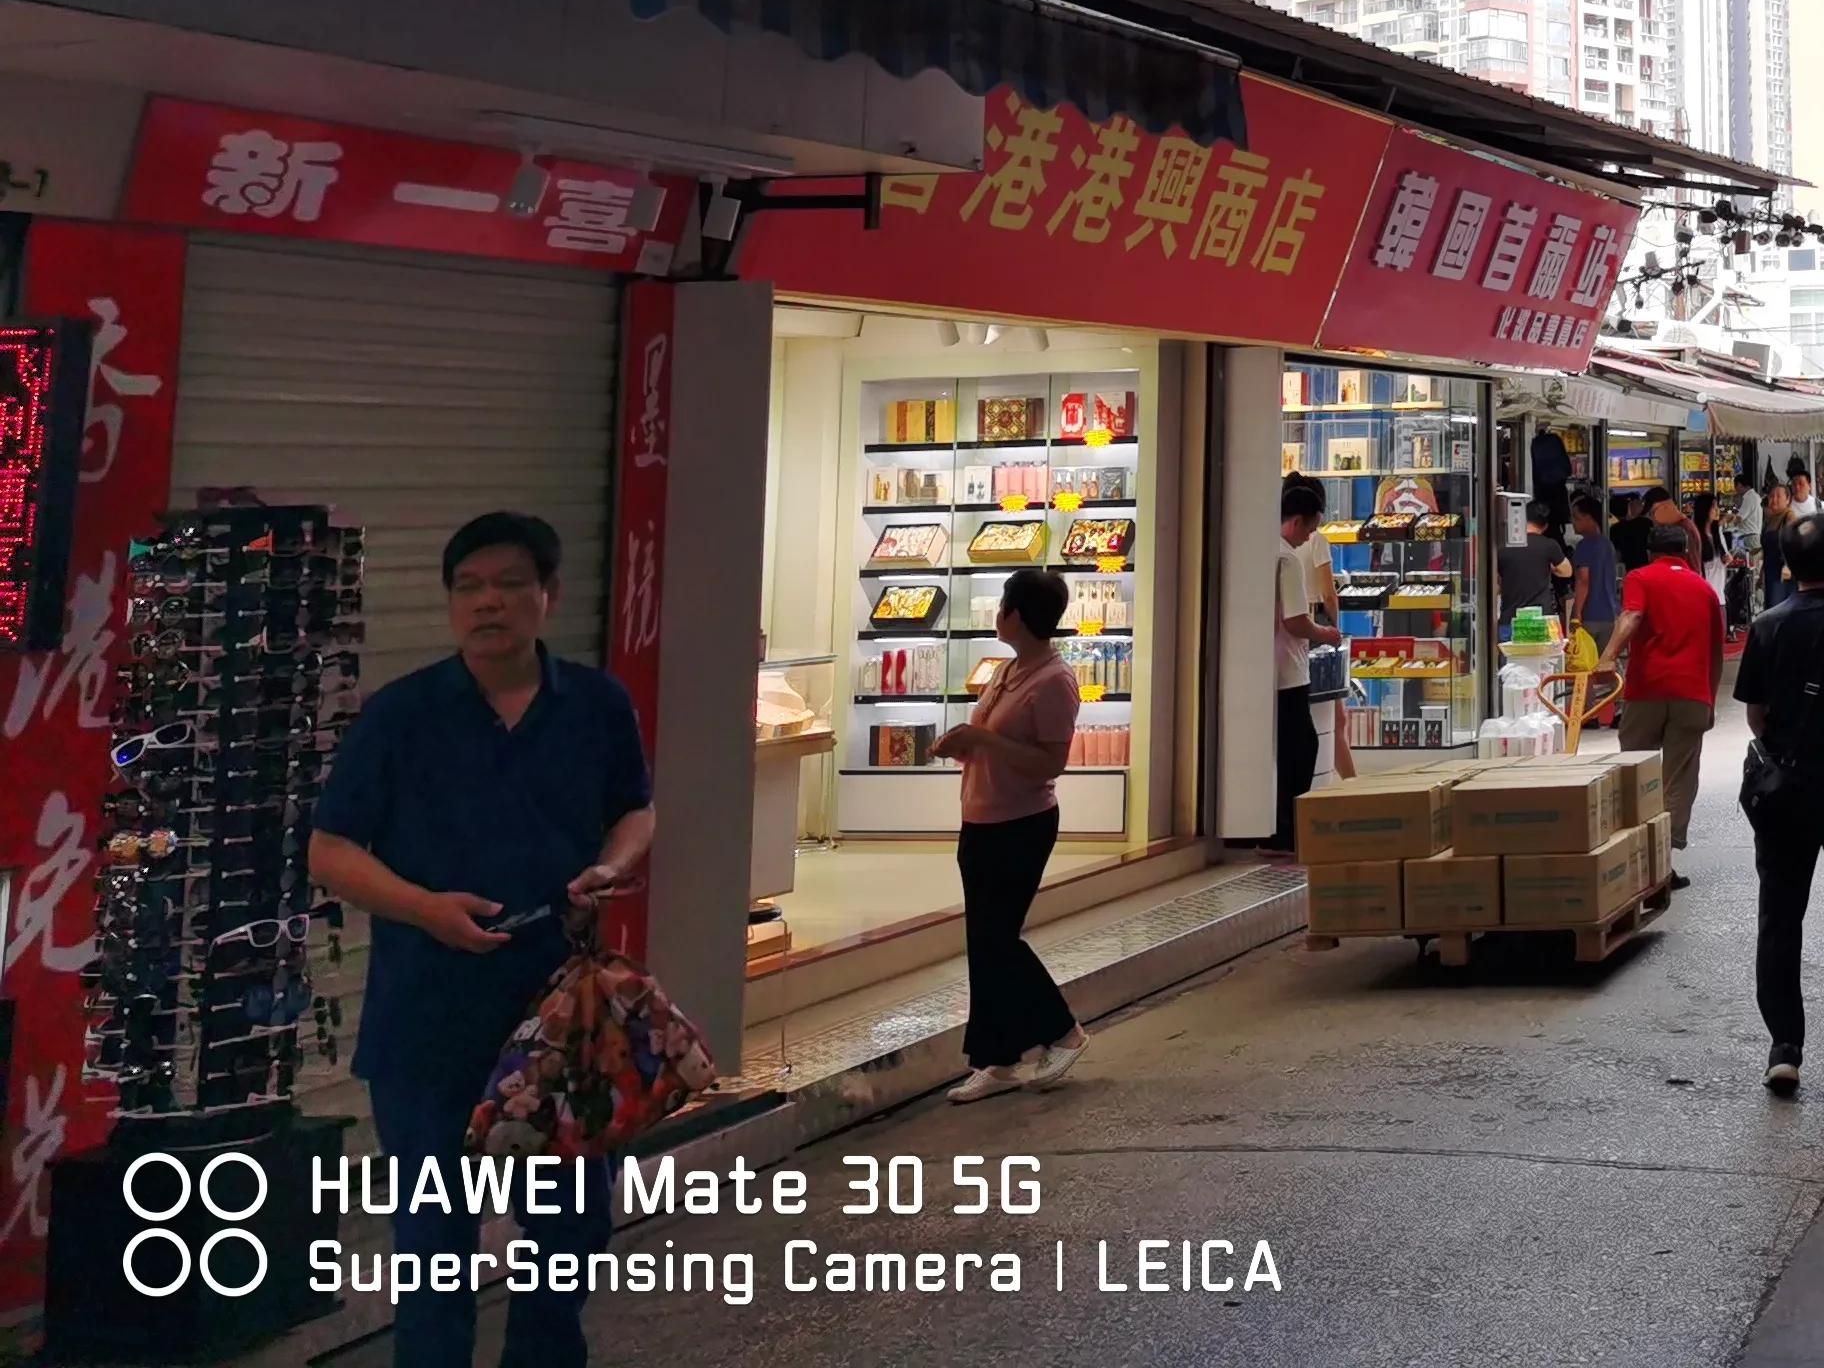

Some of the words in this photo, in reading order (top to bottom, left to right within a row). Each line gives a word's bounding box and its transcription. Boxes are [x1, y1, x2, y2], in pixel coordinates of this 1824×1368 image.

[1372, 170, 1619, 307] 韓國首爾站
